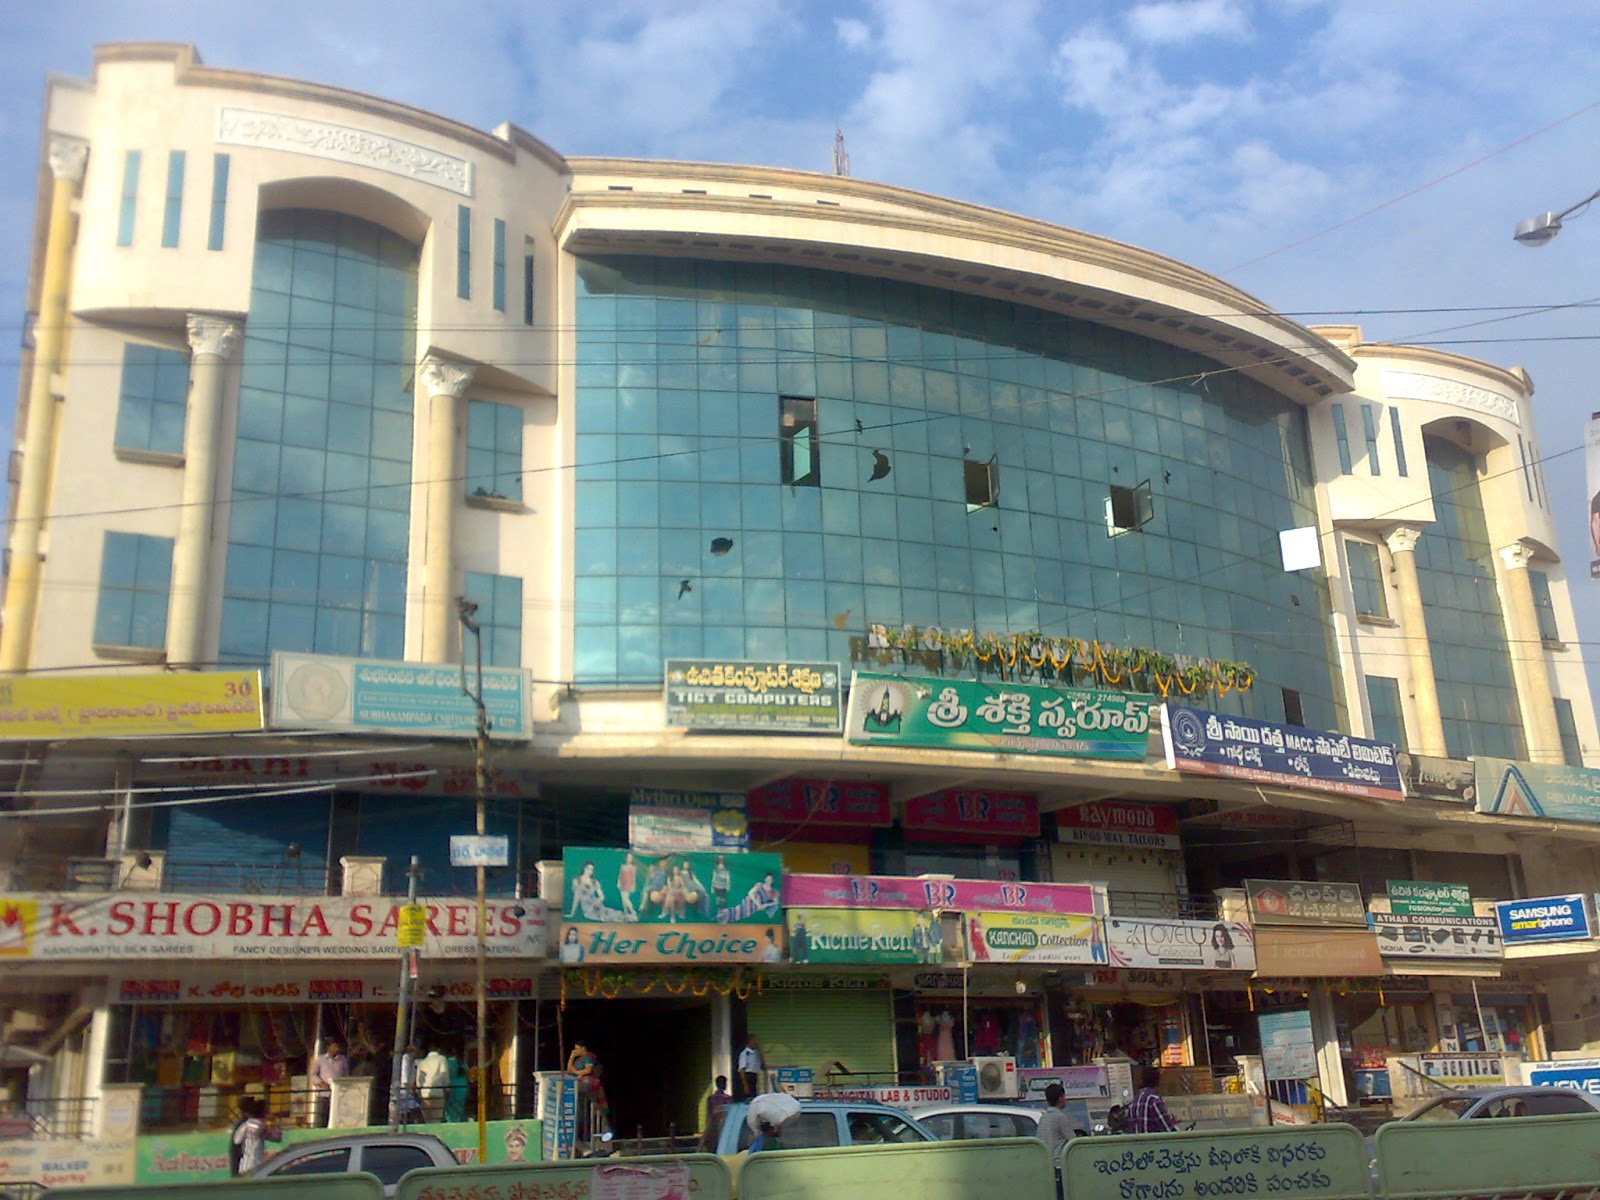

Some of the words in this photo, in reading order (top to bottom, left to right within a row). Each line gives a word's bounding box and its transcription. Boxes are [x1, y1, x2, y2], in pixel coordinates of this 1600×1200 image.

[674, 692, 717, 704] TICT
[724, 693, 832, 707] COMPUTERS
[927, 686, 968, 728] శ్రీ
[976, 690, 1031, 735] శక్తి
[1038, 696, 1149, 739] స్వరూప్
[1206, 714, 1224, 741] శ్రీ
[1223, 719, 1260, 744] సాయి
[1285, 733, 1314, 754] MACC
[107, 901, 332, 937] SHOBHA
[1376, 914, 1409, 924] ATHAR
[1412, 915, 1495, 926] COMMUNICATIONS
[1508, 905, 1572, 920] SAMSUNG
[1511, 917, 1574, 930] smartphone
[810, 922, 869, 951] Richie
[871, 924, 911, 951] Rich
[988, 931, 1037, 947] KANCHAN
[1040, 934, 1089, 948] Collection
[233, 945, 266, 955] FANCY
[269, 945, 322, 955] DESIGNER
[323, 945, 369, 955] WEDDING
[484, 945, 522, 955] ATERIAL
[588, 929, 647, 955] Her
[656, 930, 758, 960] Choice
[880, 1090, 900, 1103] LAB
[903, 1089, 910, 1102] &
[913, 1088, 951, 1102] STUDIO
